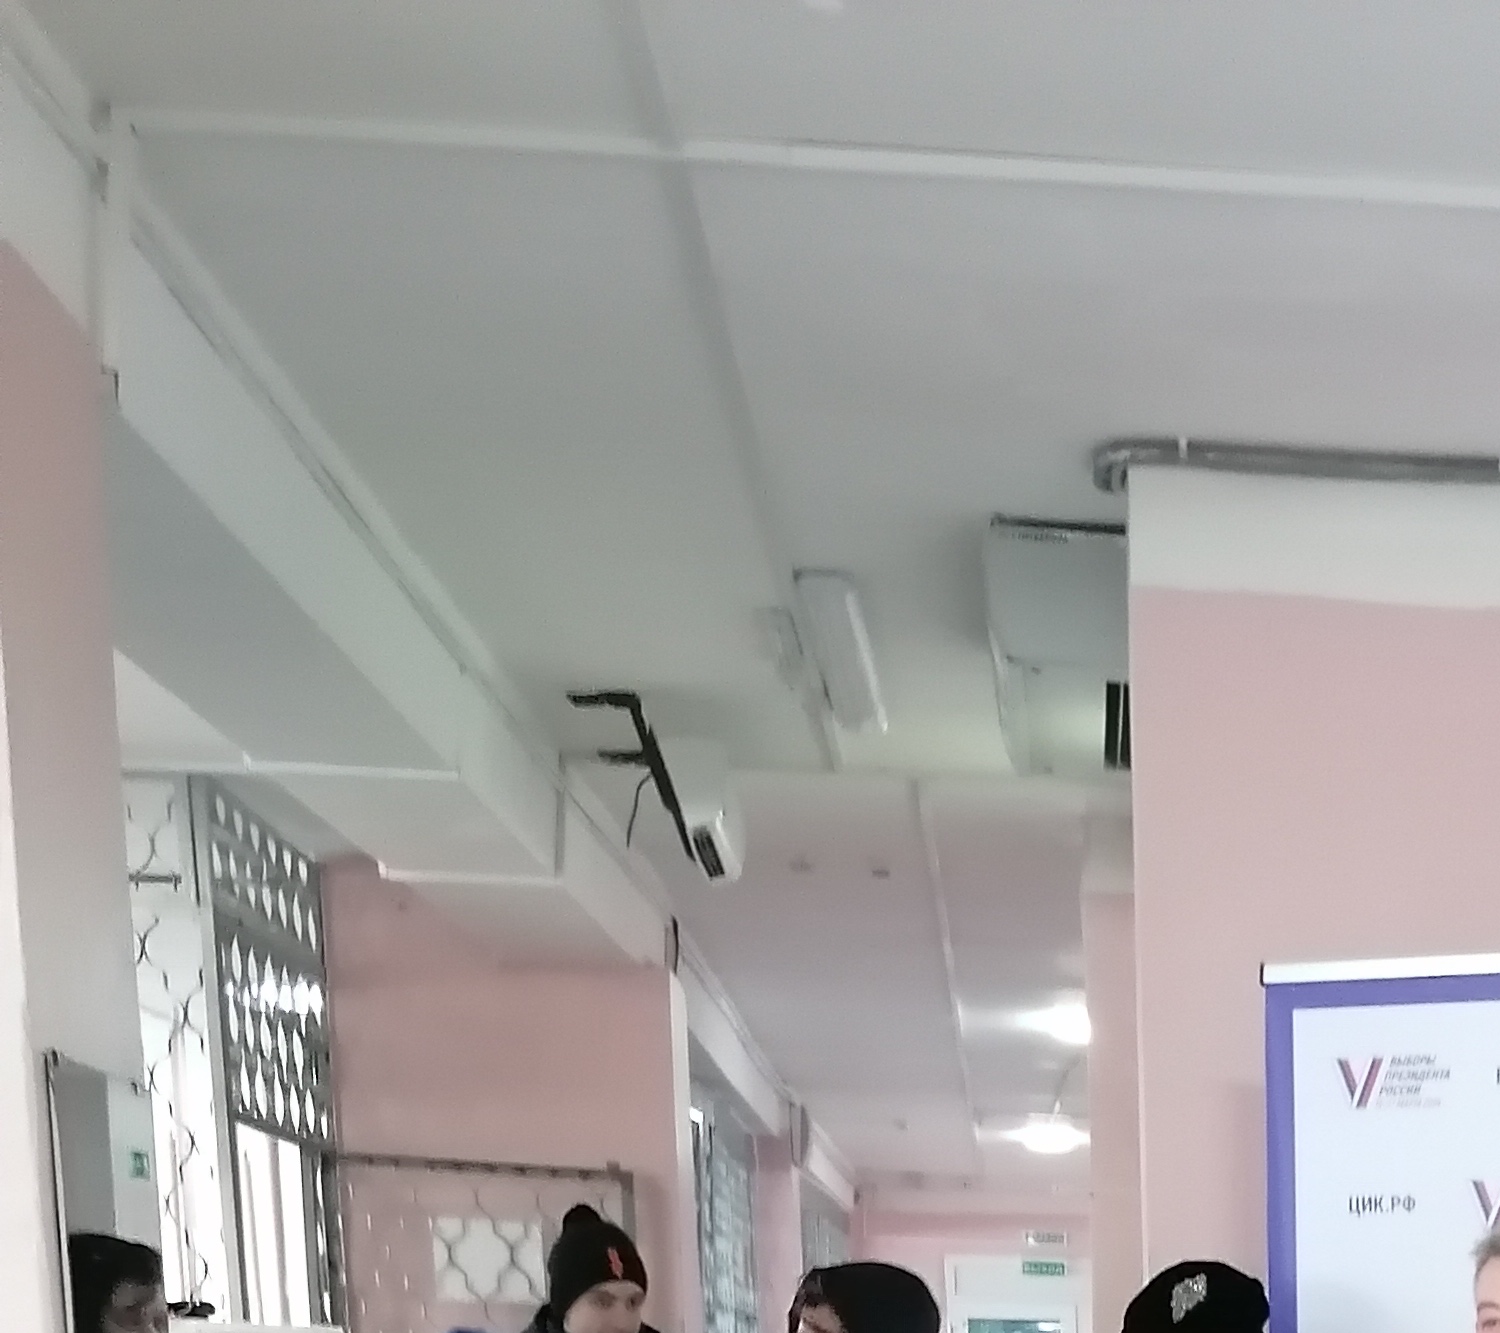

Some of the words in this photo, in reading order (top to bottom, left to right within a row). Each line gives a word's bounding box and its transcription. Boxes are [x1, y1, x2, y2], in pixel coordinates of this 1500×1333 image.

[1390, 1054, 1437, 1067] ВЫБОРЫ
[1383, 1068, 1451, 1082] ПРЕЗИДЕНТА
[1378, 1085, 1422, 1097] РОССИИ
[1348, 1194, 1416, 1217] ЦИК.РФ
